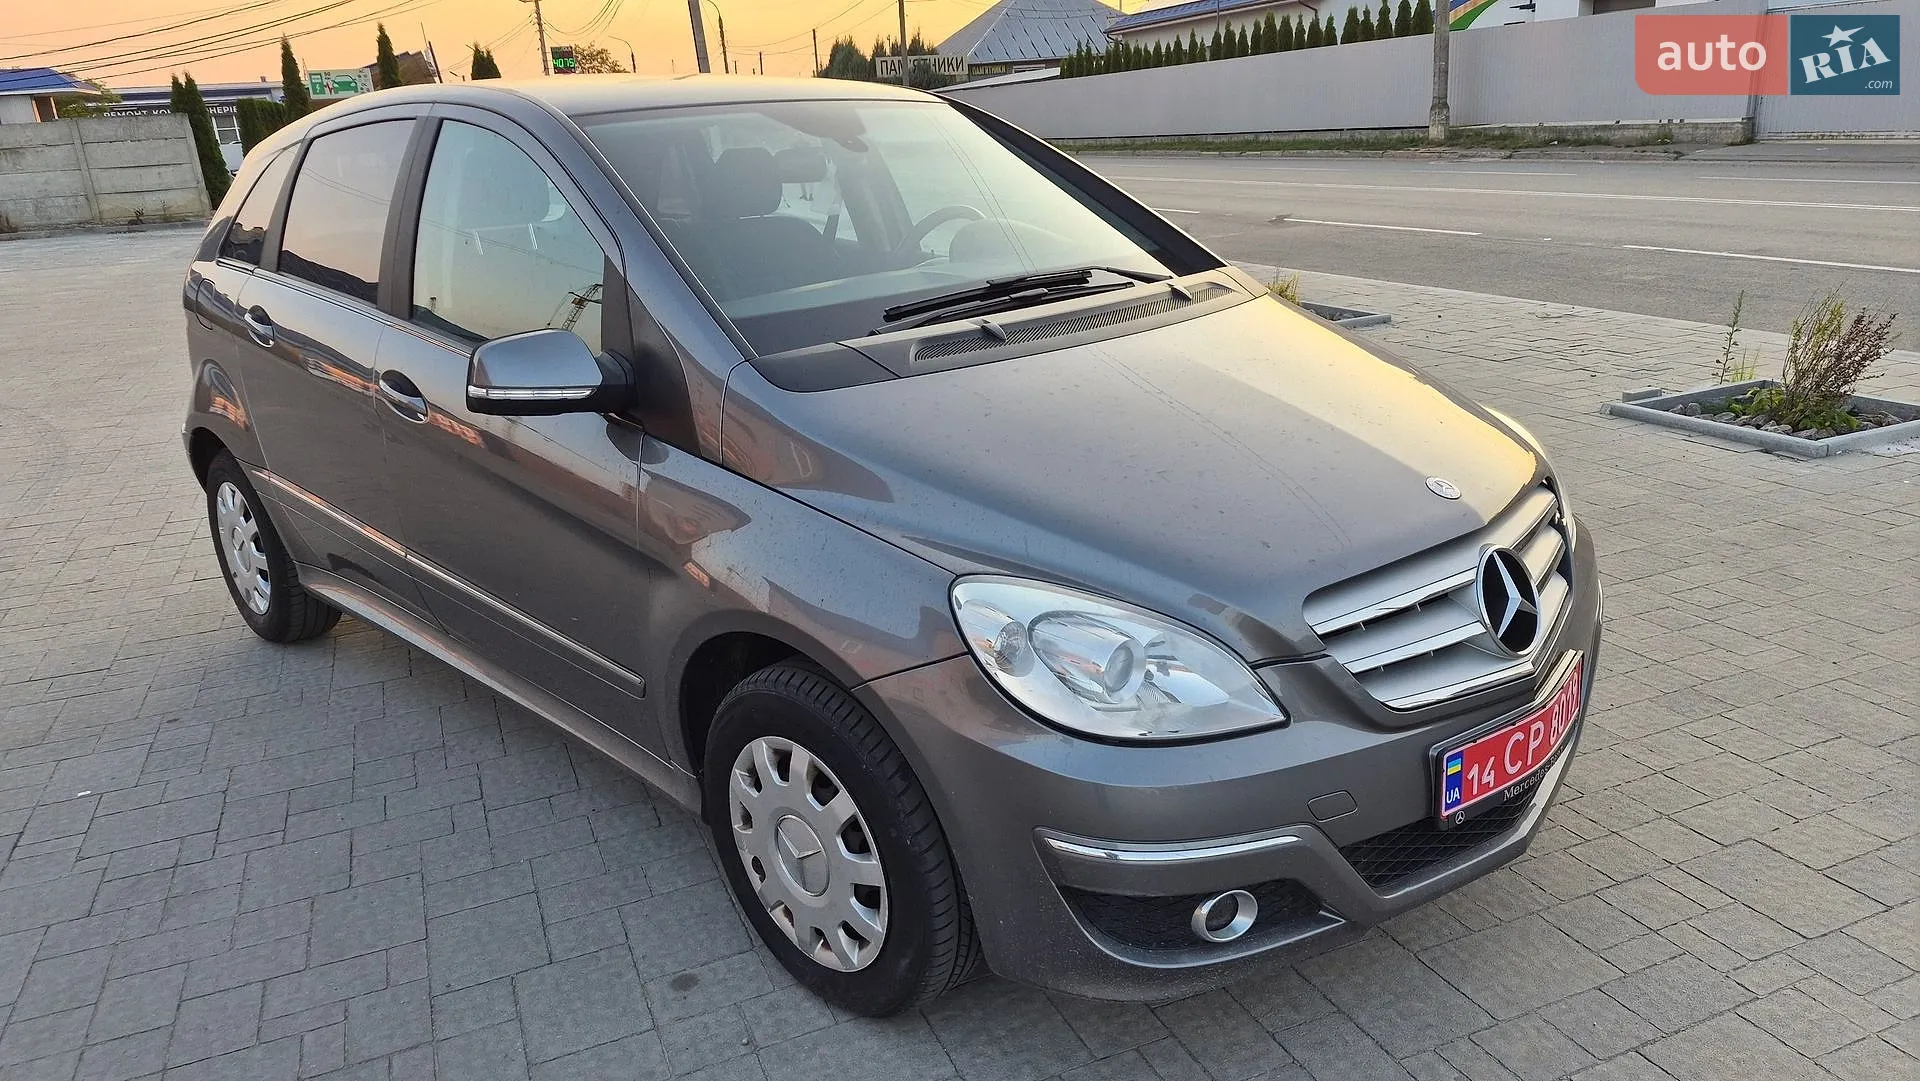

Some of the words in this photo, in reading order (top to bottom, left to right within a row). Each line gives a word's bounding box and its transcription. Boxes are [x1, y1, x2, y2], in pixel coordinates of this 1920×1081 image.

[1446, 787, 1460, 803] UA
[1467, 756, 1496, 796] 14
[1503, 720, 1545, 775] CP
